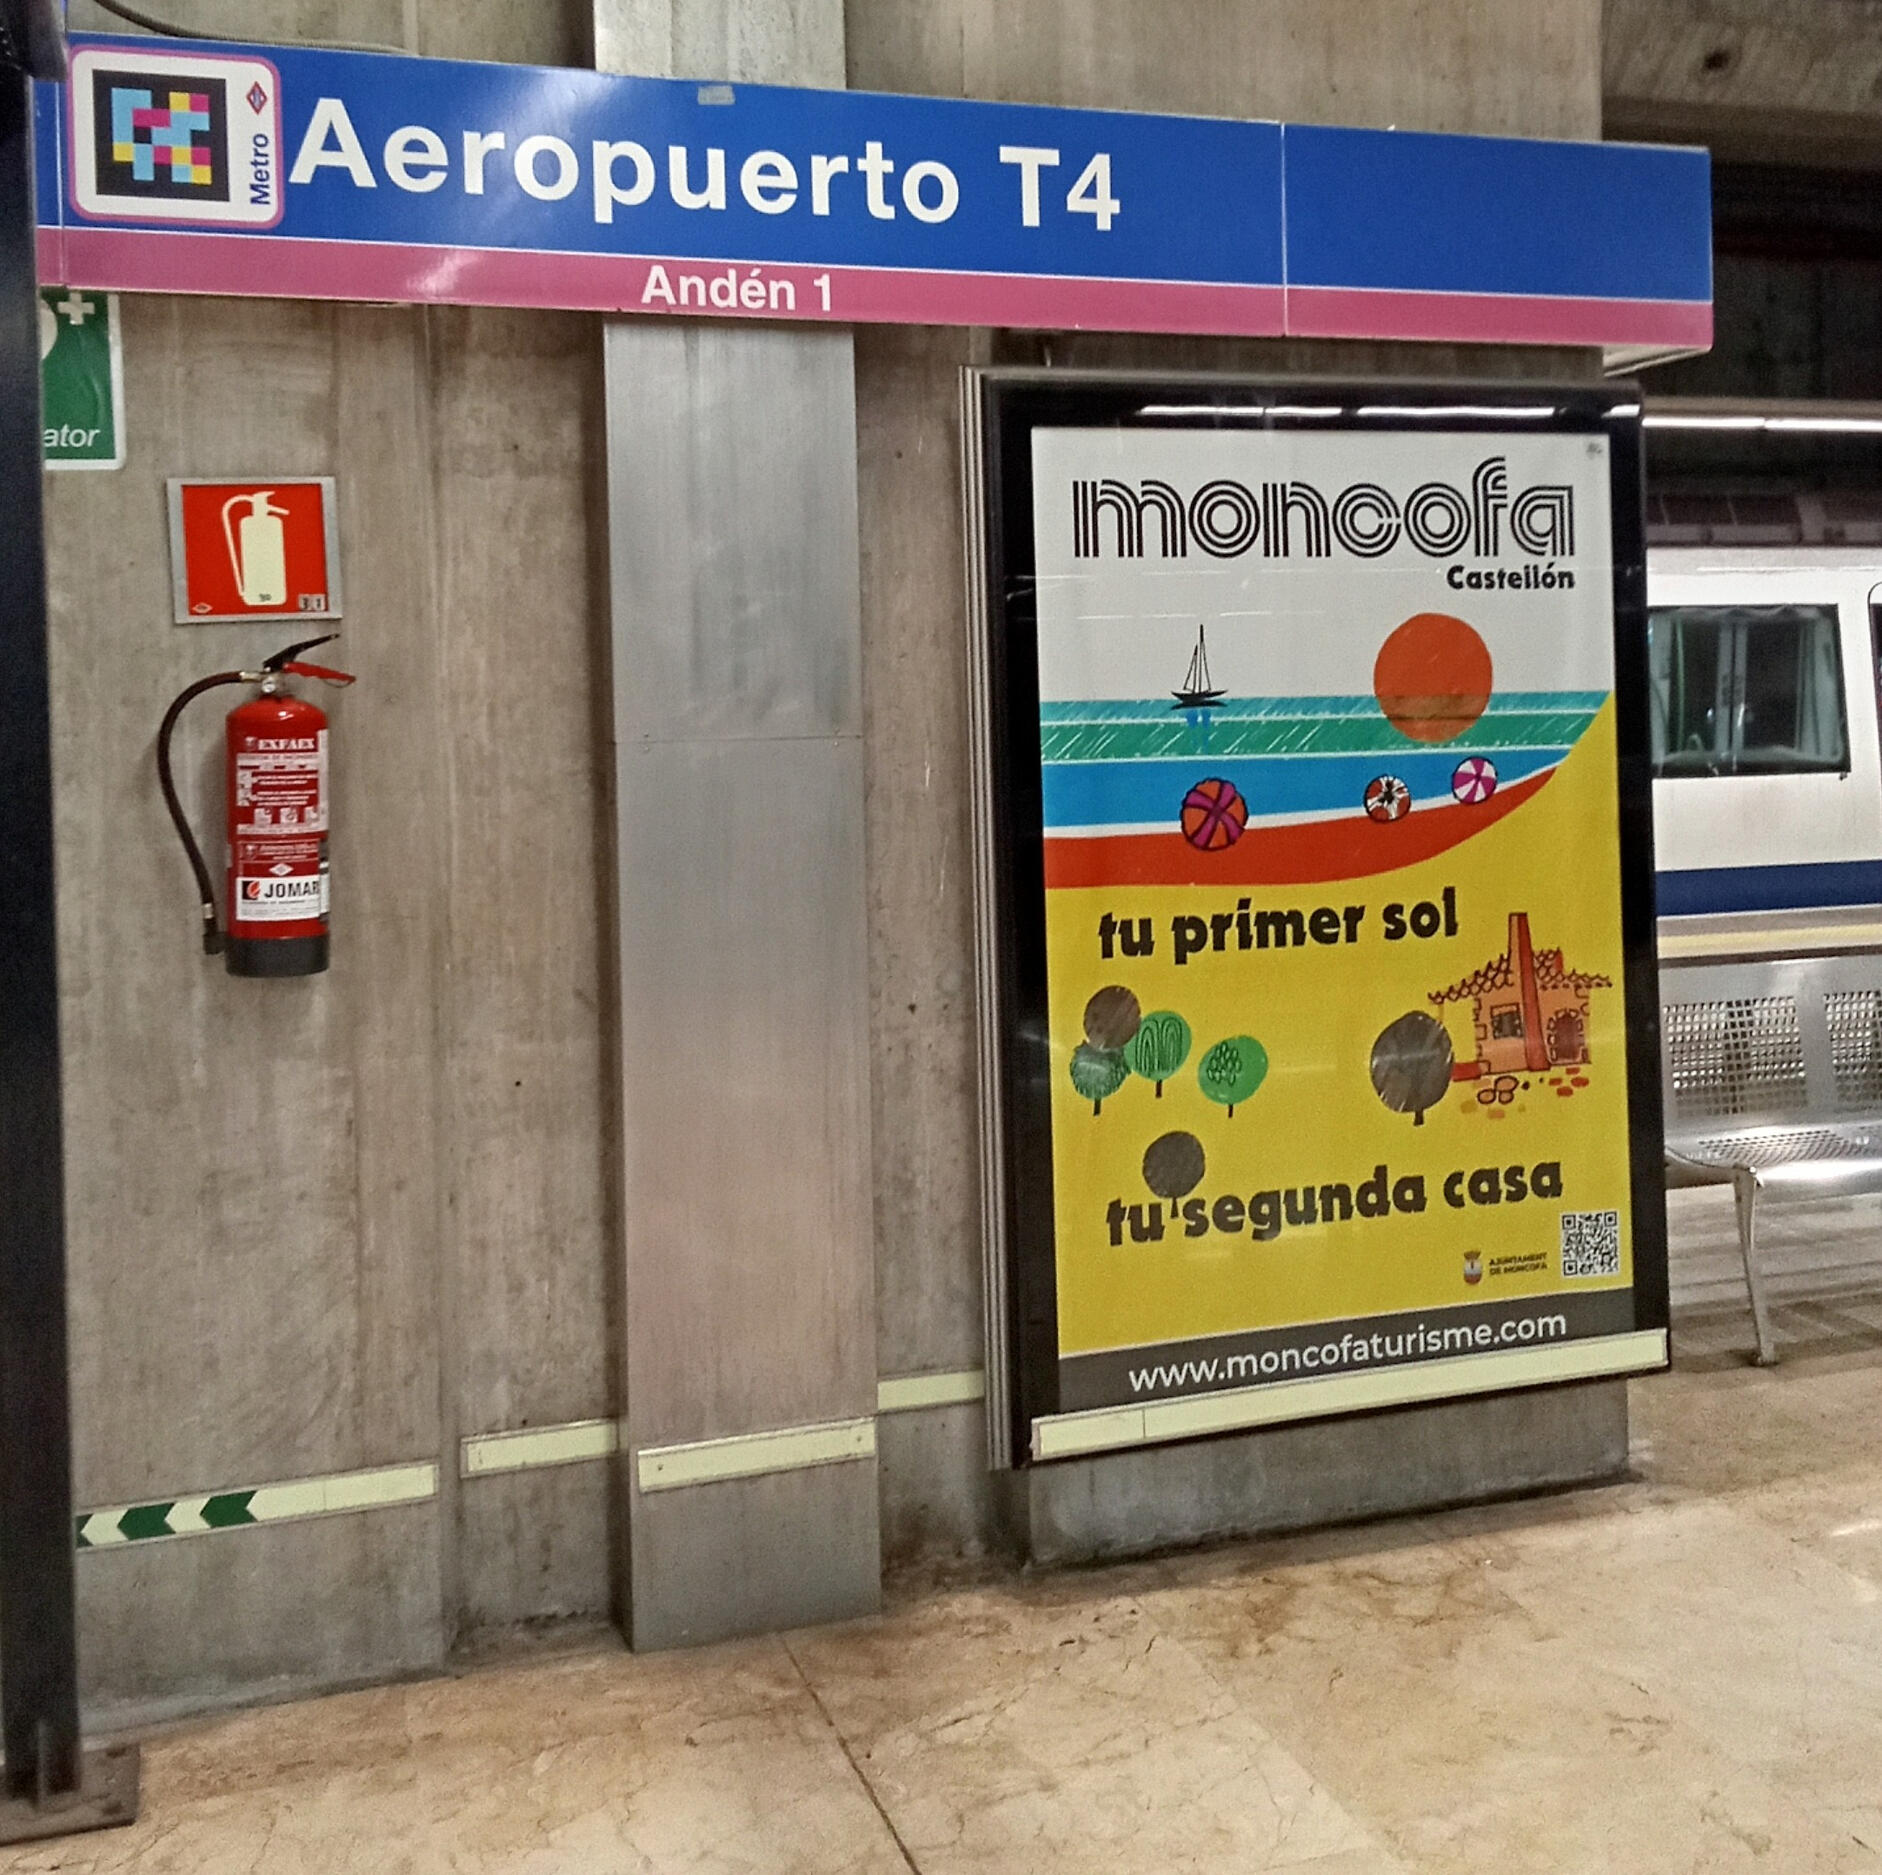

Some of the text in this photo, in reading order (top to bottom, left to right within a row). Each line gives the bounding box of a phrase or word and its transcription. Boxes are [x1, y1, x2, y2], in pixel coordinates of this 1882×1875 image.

[249, 133, 271, 205] Metro
[289, 98, 1120, 231] Aeropuerto T4
[642, 265, 833, 312] Andén 1
[1072, 456, 1575, 558] moncofa
[1446, 561, 1576, 590] Castellón
[1098, 886, 1459, 966] tu primer sol
[1106, 1161, 1564, 1247] tu segunda casa
[1129, 1311, 1567, 1393] www.moncofaturisme.com
